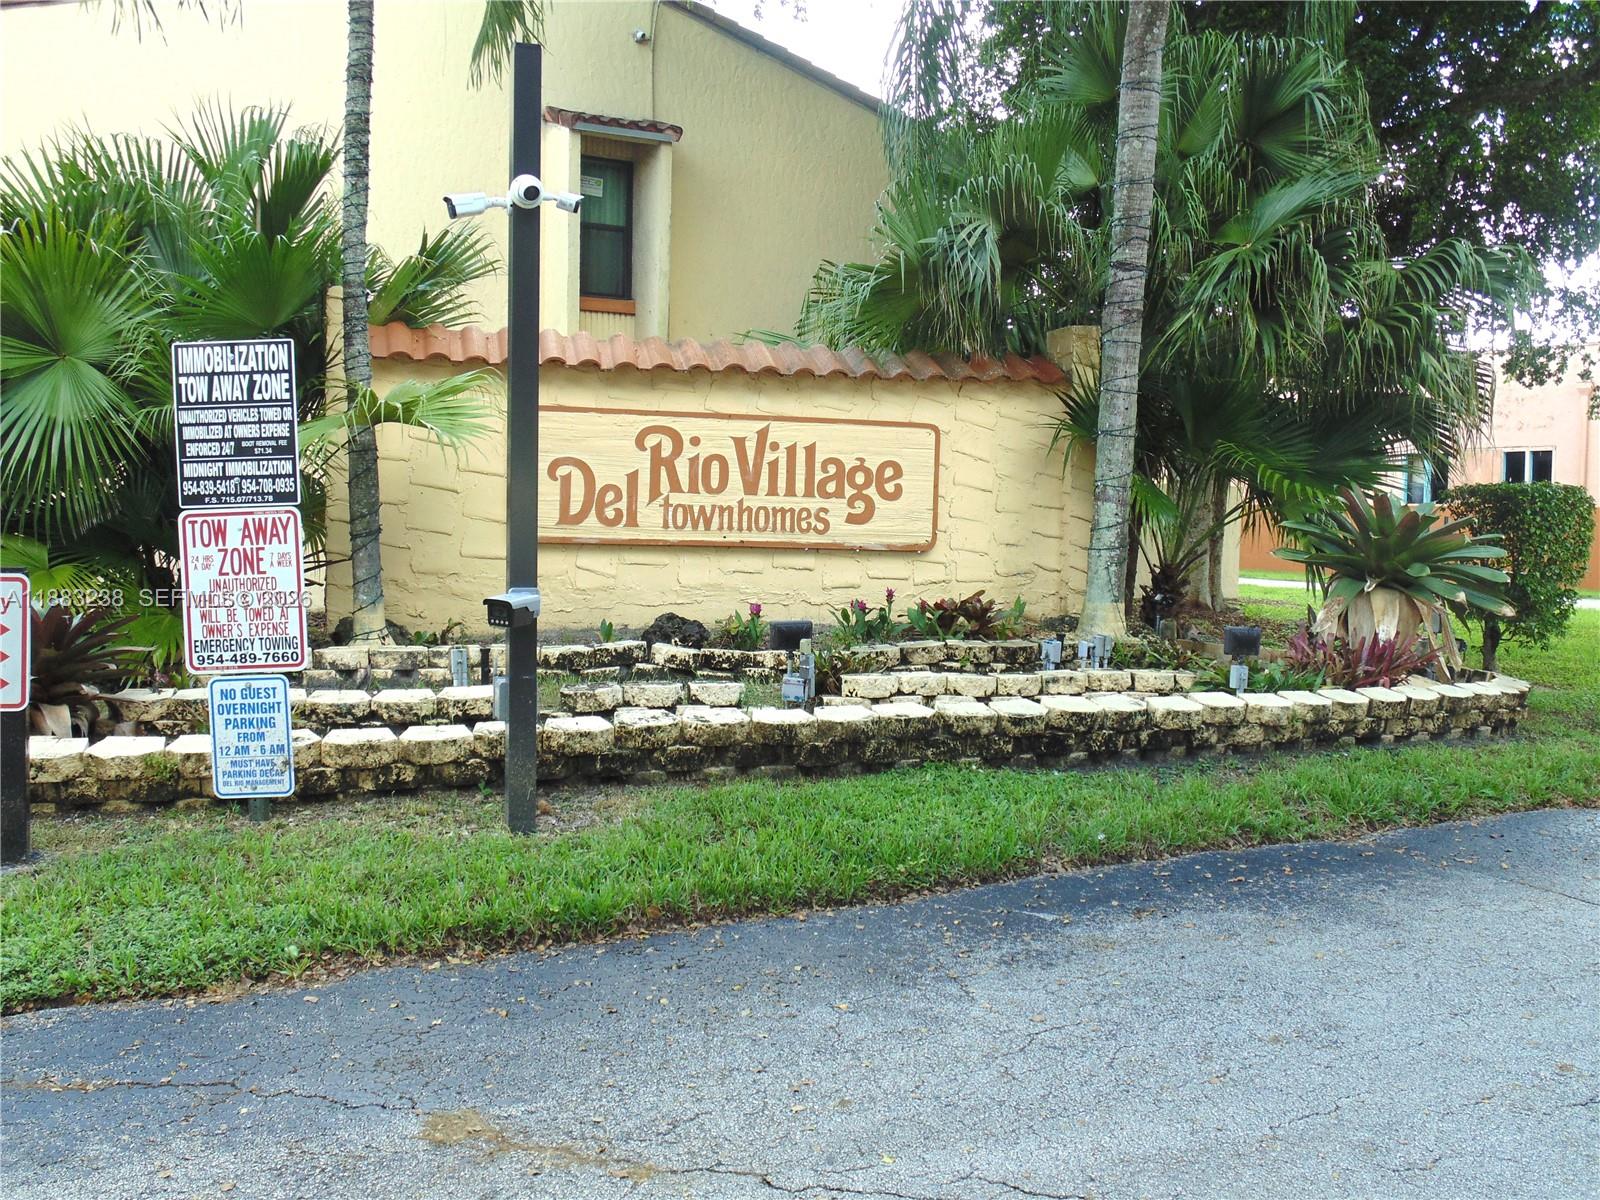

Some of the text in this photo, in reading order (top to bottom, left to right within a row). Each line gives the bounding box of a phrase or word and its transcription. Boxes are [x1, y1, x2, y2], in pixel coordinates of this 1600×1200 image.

[178, 344, 288, 374] IMMOBILIZATION
[179, 373, 290, 403] TOW AWAY ZONE
[179, 407, 292, 424] UNAUTHORIZED VEHICLES TOWED OR
[182, 424, 290, 439] IMMOBILIZED AT OWNERS EXPENSE
[186, 443, 220, 456] ENFORCED
[184, 461, 292, 477] MIDNIGHT IMMOBILIZATION
[546, 422, 903, 527] Del Rio Village
[183, 480, 235, 495] 954-839-5418
[242, 478, 295, 493] 954-708-0935
[658, 494, 831, 535] townhomes
[188, 516, 291, 548] TOW AWAY
[218, 547, 267, 576] ZONE
[270, 559, 293, 568] A WEEK
[209, 577, 277, 592] UNAUTHORIZED
[200, 607, 289, 623] WILL BE TOWED AT
[202, 622, 290, 639] OWNER'S EXPENSE
[194, 636, 298, 654] EMERGENCY TOWING
[197, 651, 299, 666] 954-489-7660
[220, 687, 277, 701] NO GUEST
[218, 701, 282, 716] OVERNIGHT
[225, 717, 276, 730] PARKING
[238, 732, 265, 742] FROM
[219, 746, 231, 756] 12
[234, 745, 250, 755] AM
[261, 745, 266, 754] 6
[270, 744, 285, 754] AM
[231, 759, 275, 768] MUST HAVE
[223, 769, 285, 778] PARKING DECAL
